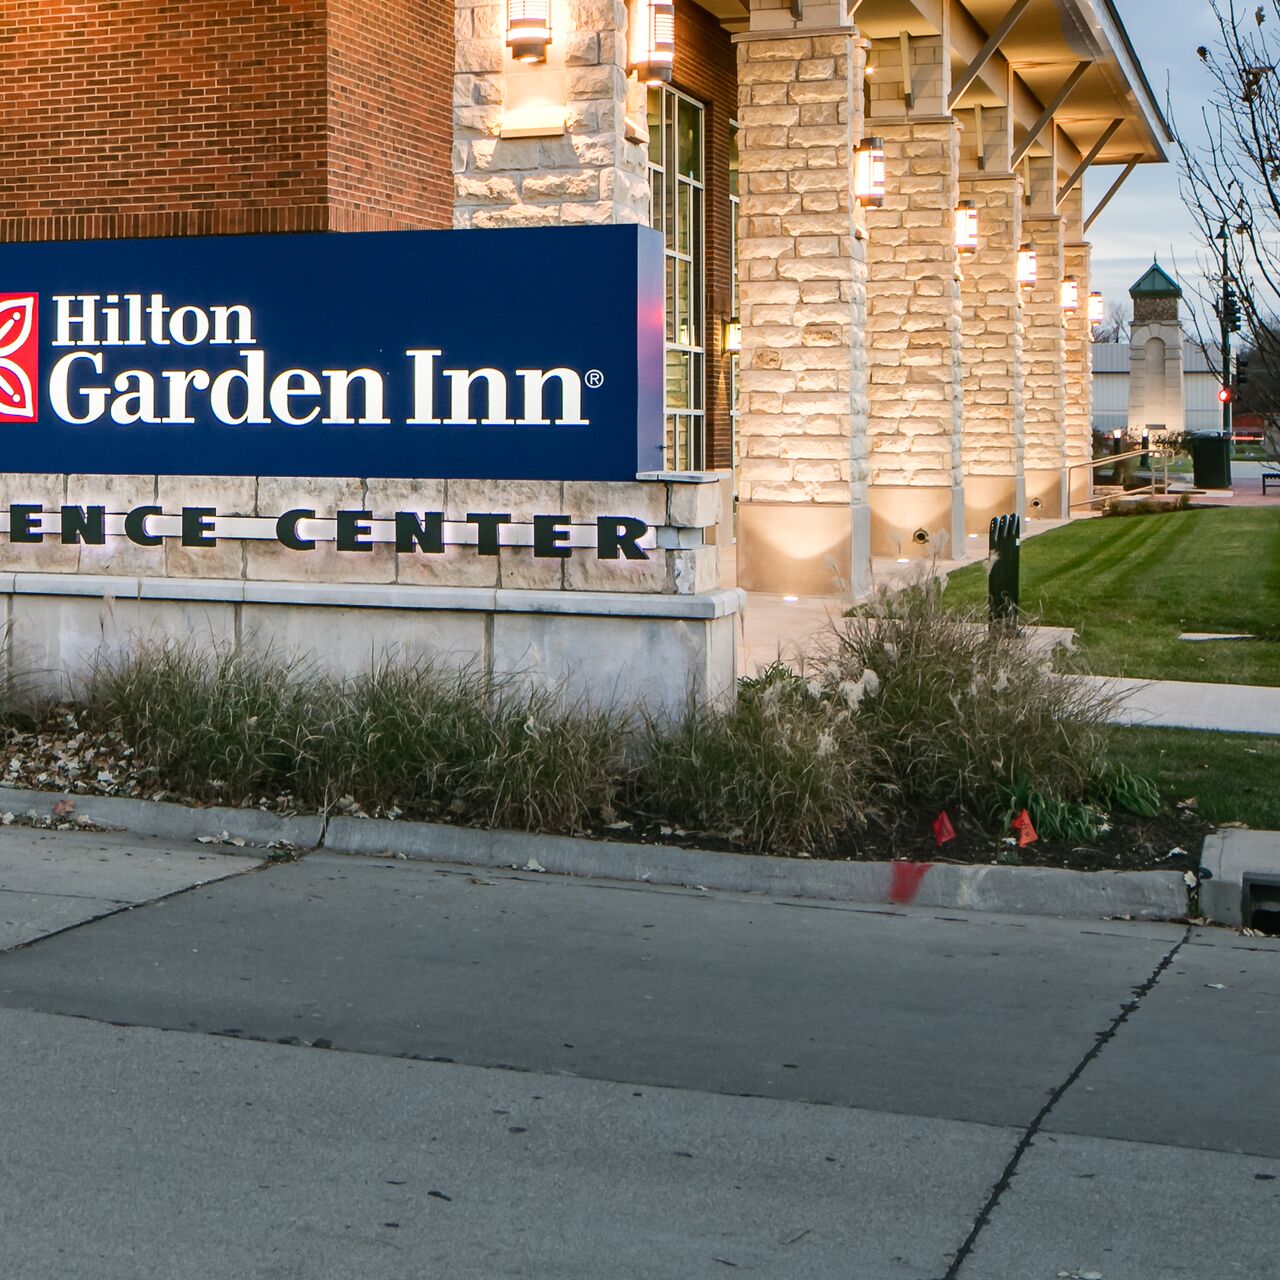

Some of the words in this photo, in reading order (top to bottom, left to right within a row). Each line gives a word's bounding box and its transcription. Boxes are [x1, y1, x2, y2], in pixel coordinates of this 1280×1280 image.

[51, 293, 257, 347] Hilton
[48, 348, 392, 426] Garden
[274, 507, 651, 561] CENTER
